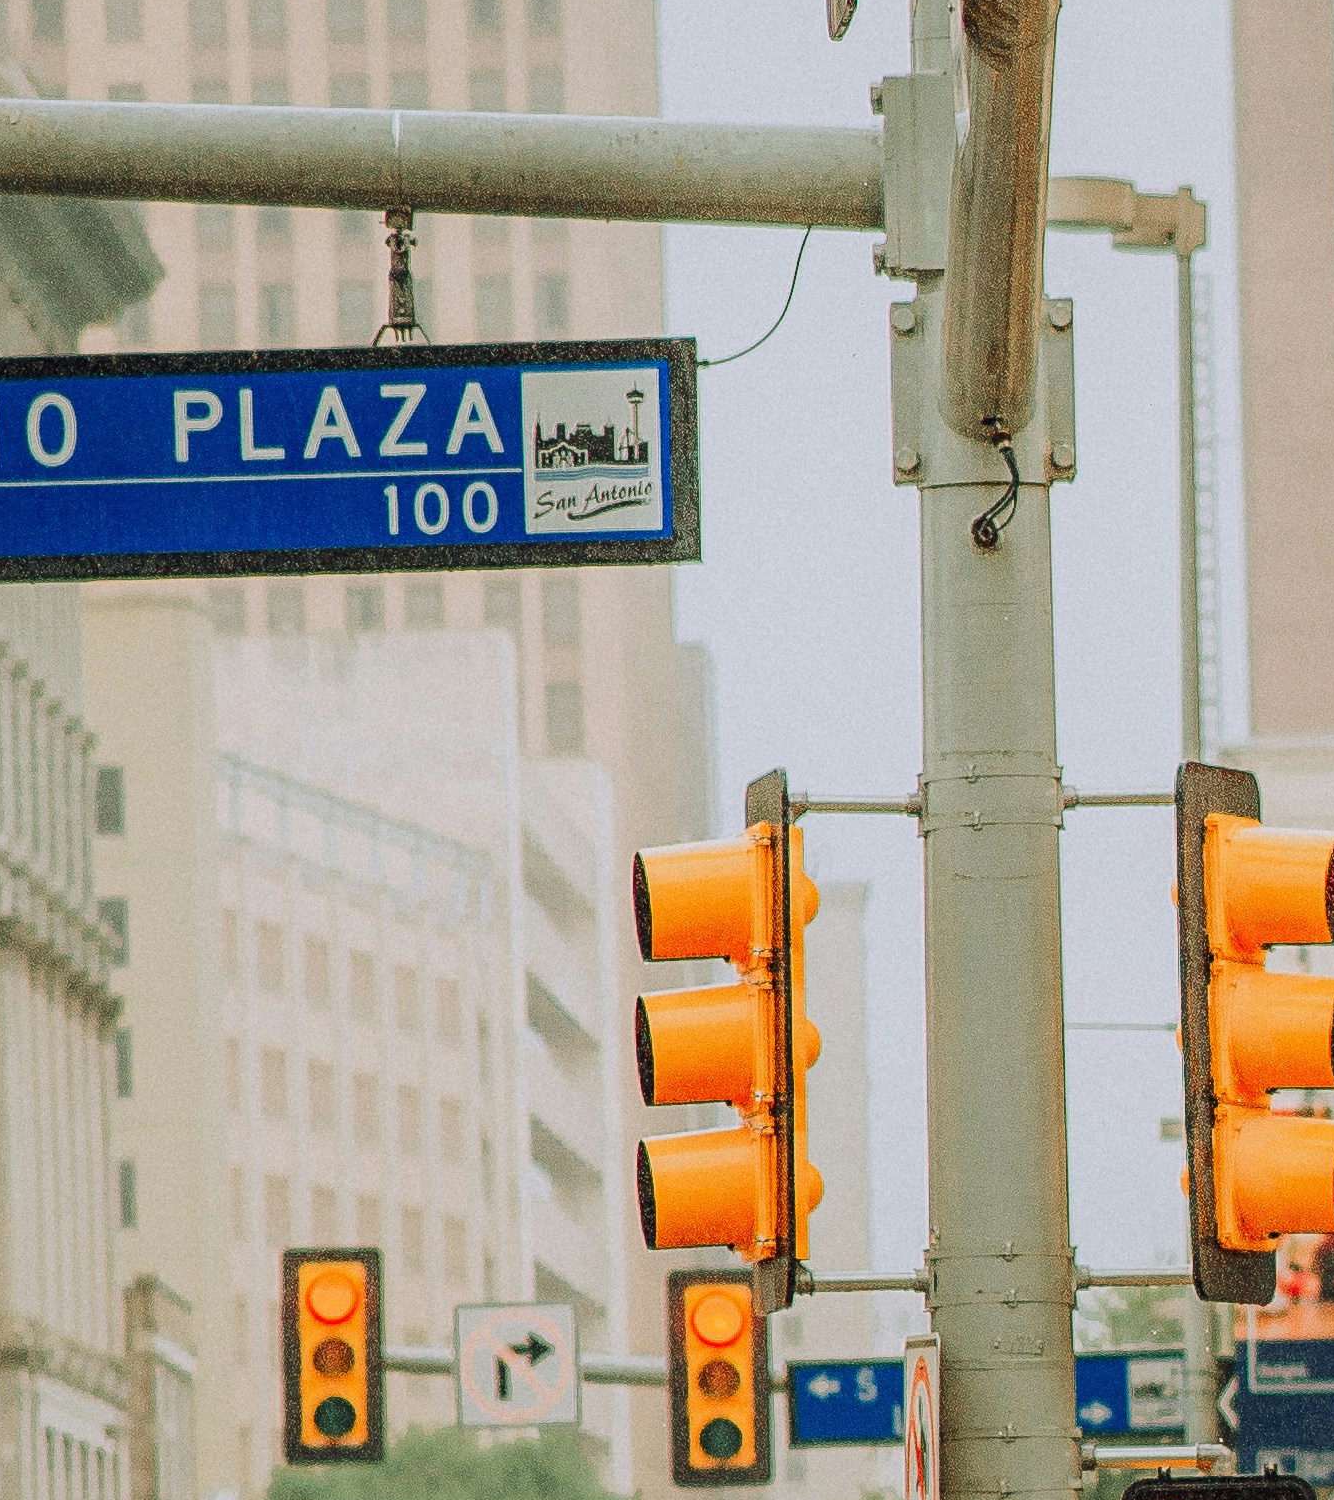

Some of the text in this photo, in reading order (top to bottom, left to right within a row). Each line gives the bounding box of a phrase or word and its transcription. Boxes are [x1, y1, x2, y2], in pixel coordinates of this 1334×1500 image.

[174, 382, 507, 464] PLAZA
[383, 481, 499, 536] 100
[533, 480, 653, 520] San Antonio
